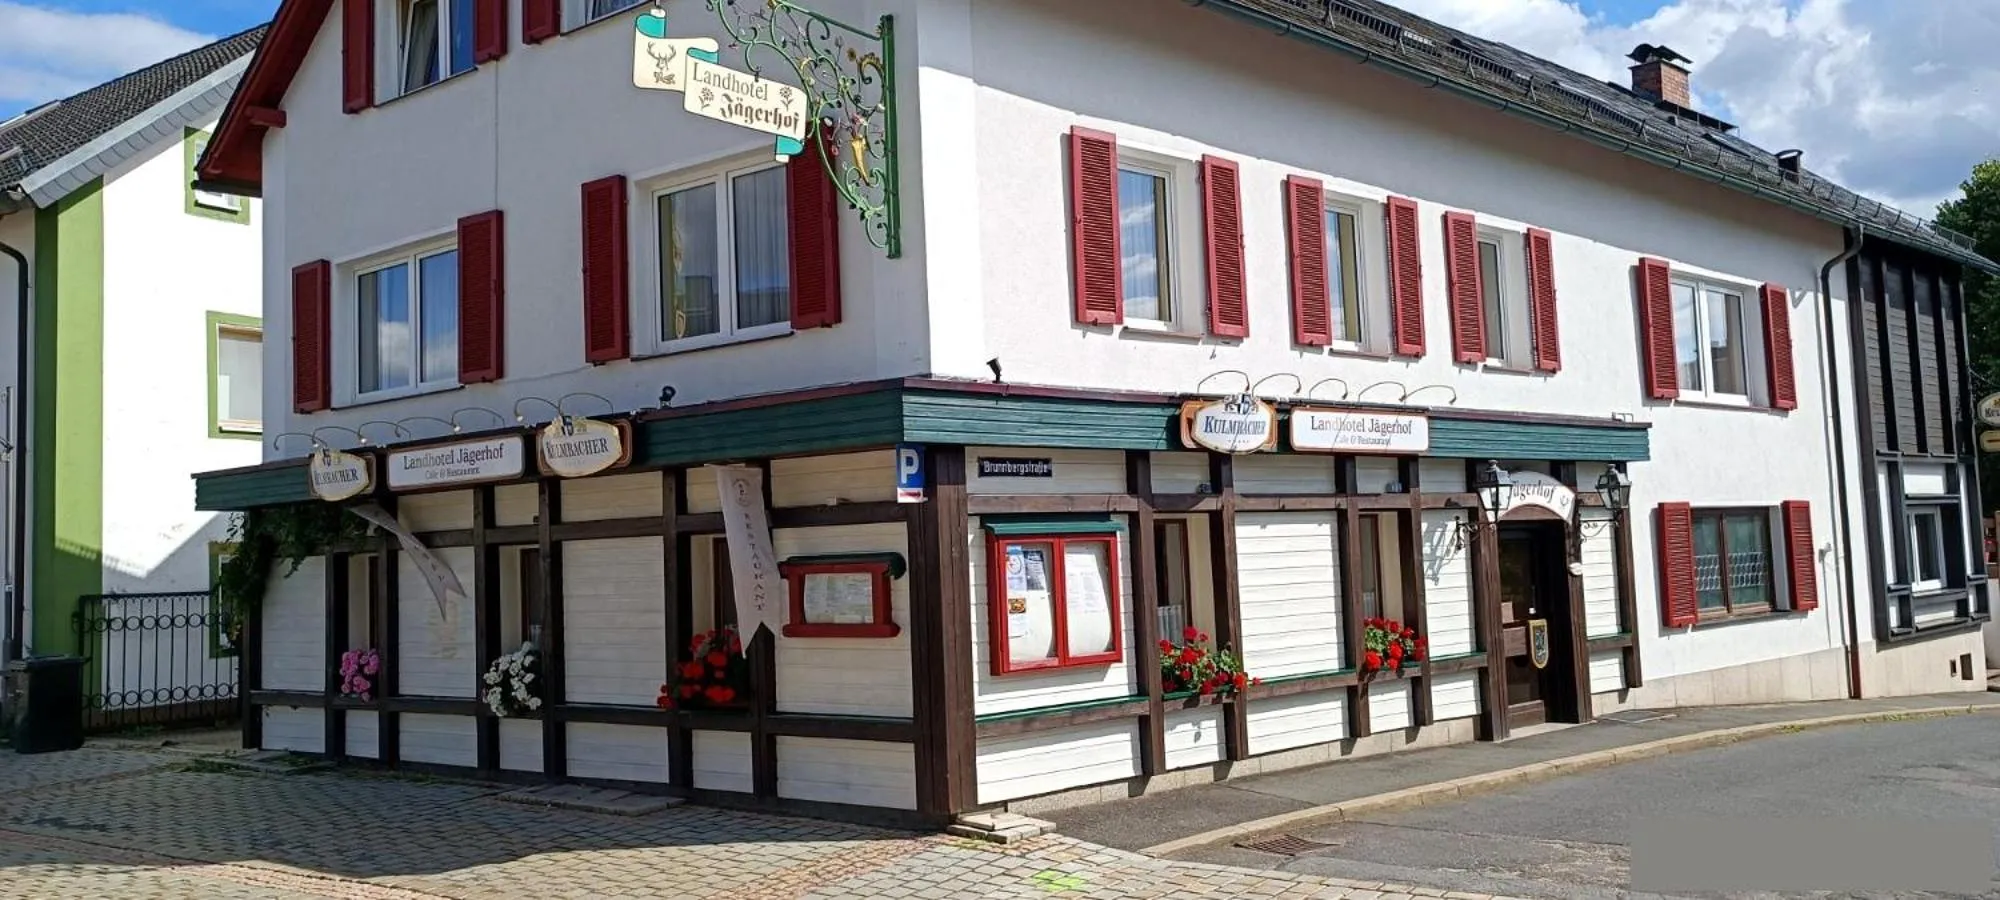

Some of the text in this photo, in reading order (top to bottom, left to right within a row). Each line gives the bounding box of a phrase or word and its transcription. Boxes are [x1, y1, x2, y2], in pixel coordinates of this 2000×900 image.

[693, 62, 768, 101] Landhotel
[720, 93, 800, 134] Jägerhof
[1204, 415, 1266, 435] KULMBACHER
[1311, 415, 1413, 436] Landhotel Jägerhof
[403, 442, 505, 471] Landhotel Jägerhof
[546, 436, 609, 459] KULMBACHER
[900, 448, 919, 484] P
[983, 460, 1049, 476] Brunnbergstraße
[1512, 479, 1557, 504] ägerhof
[743, 512, 766, 612] RESTAURANT
